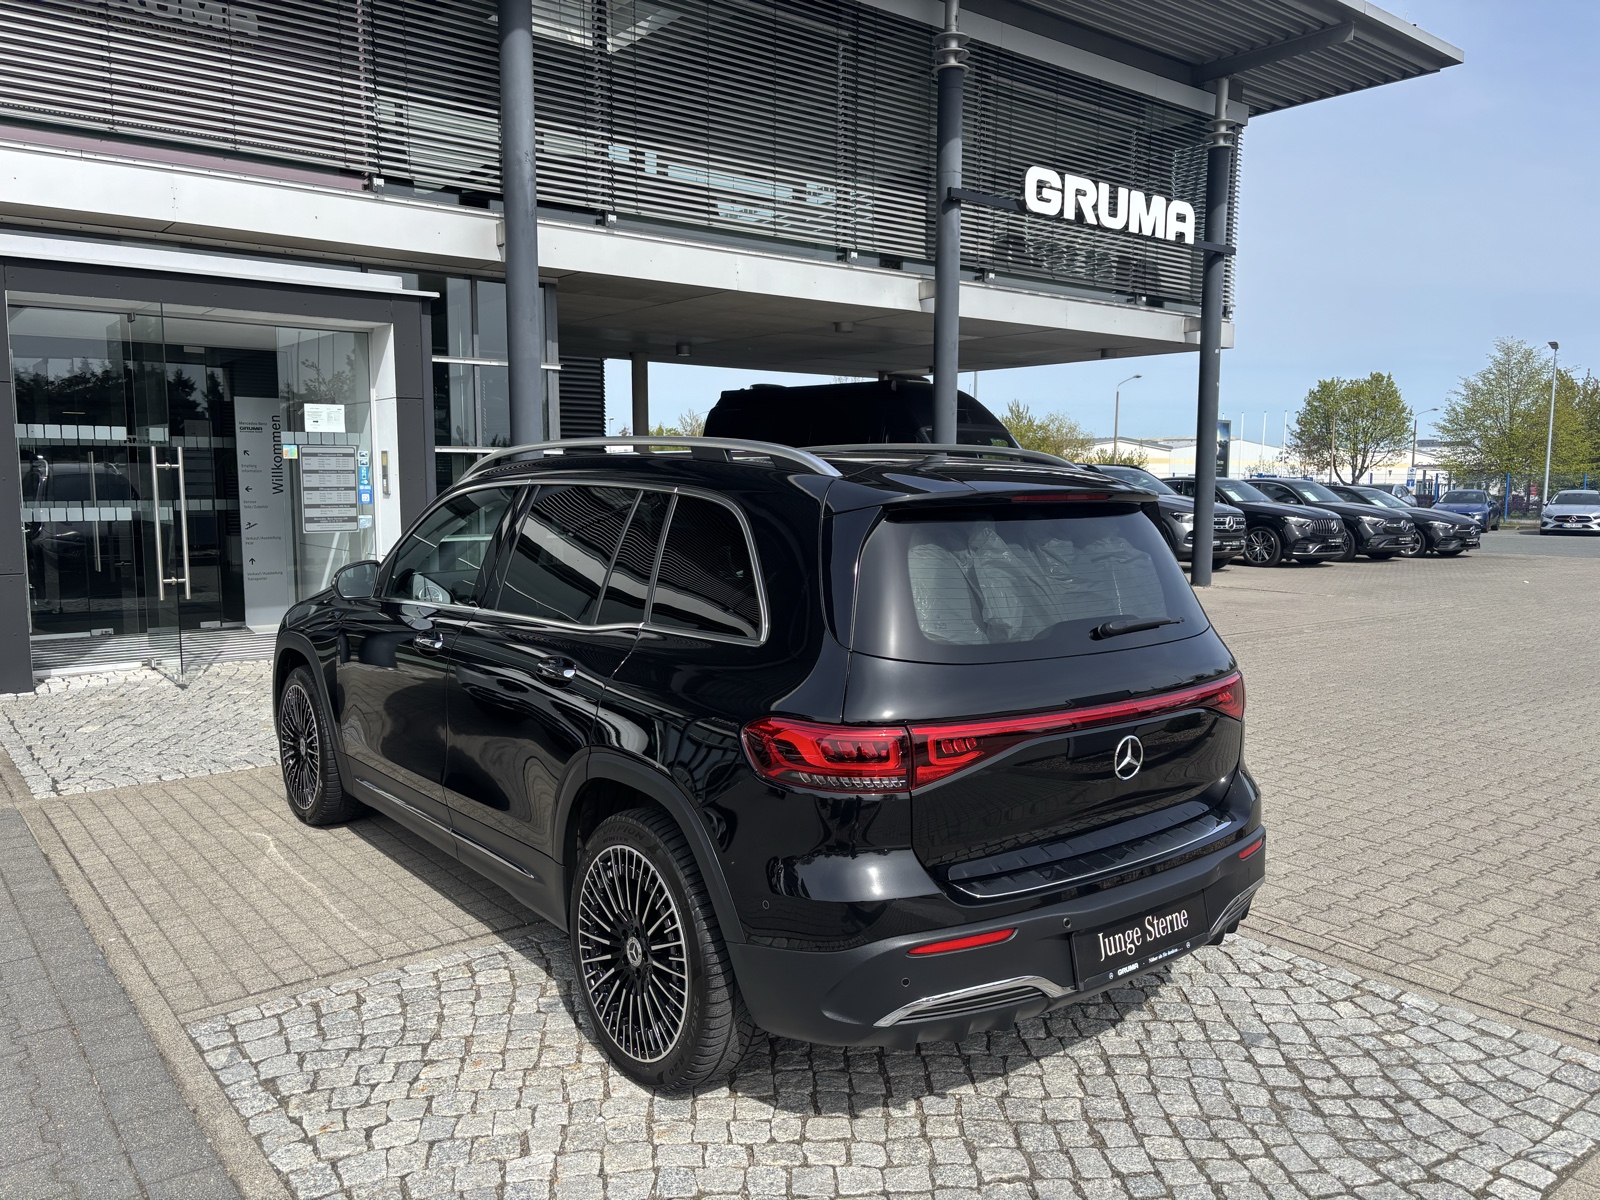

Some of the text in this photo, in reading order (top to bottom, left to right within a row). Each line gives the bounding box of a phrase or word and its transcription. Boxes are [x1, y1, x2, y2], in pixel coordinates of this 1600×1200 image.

[1024, 165, 1196, 245] GRUMA
[271, 415, 284, 495] Willkommen
[1097, 909, 1189, 962] Junge Sterne
[1117, 962, 1139, 976] GRUMA
